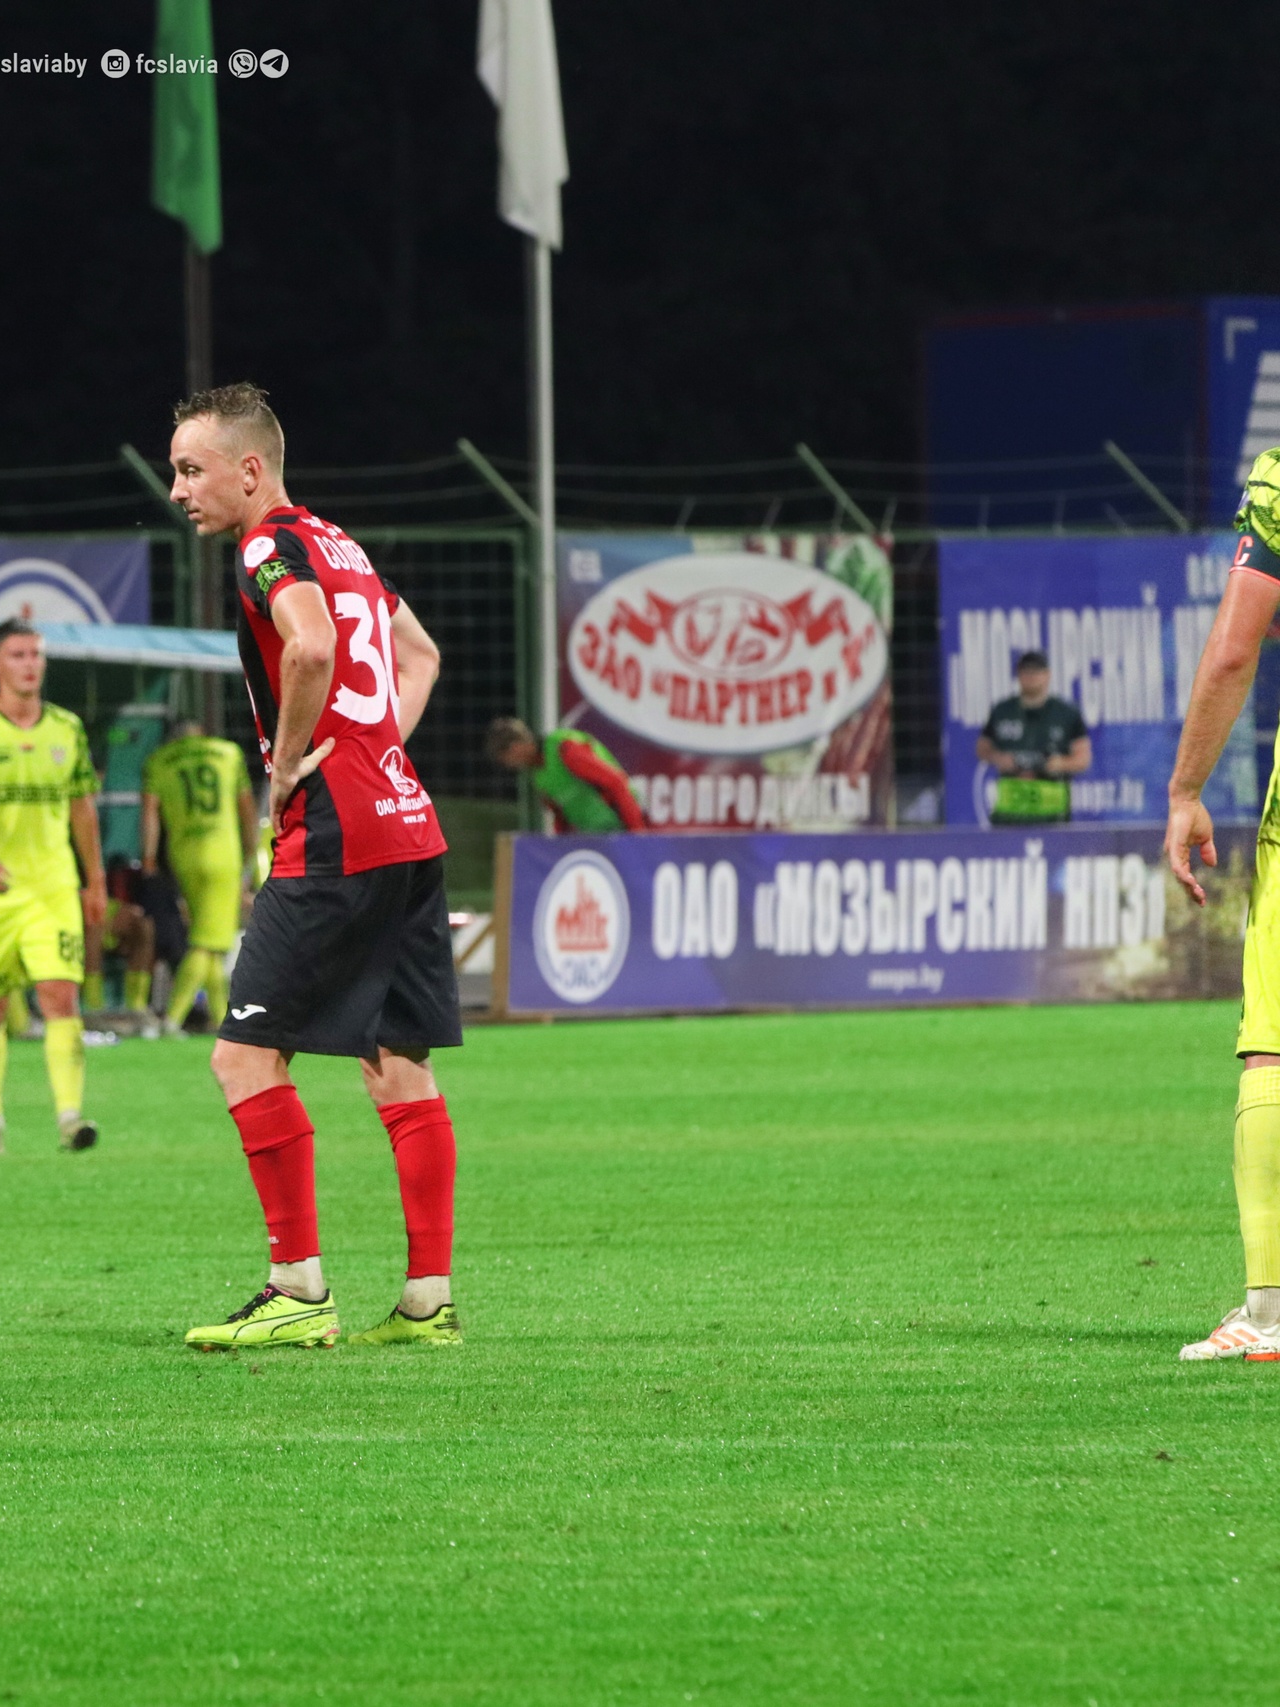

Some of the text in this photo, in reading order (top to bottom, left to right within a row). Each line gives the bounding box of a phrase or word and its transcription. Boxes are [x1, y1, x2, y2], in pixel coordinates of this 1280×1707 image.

[577, 622, 643, 701] ЗАО
[179, 763, 221, 816] 19
[375, 797, 397, 817] ОАО
[651, 859, 739, 960] ОАО
[754, 838, 1049, 958] «МОЗЫРСКИЙ
